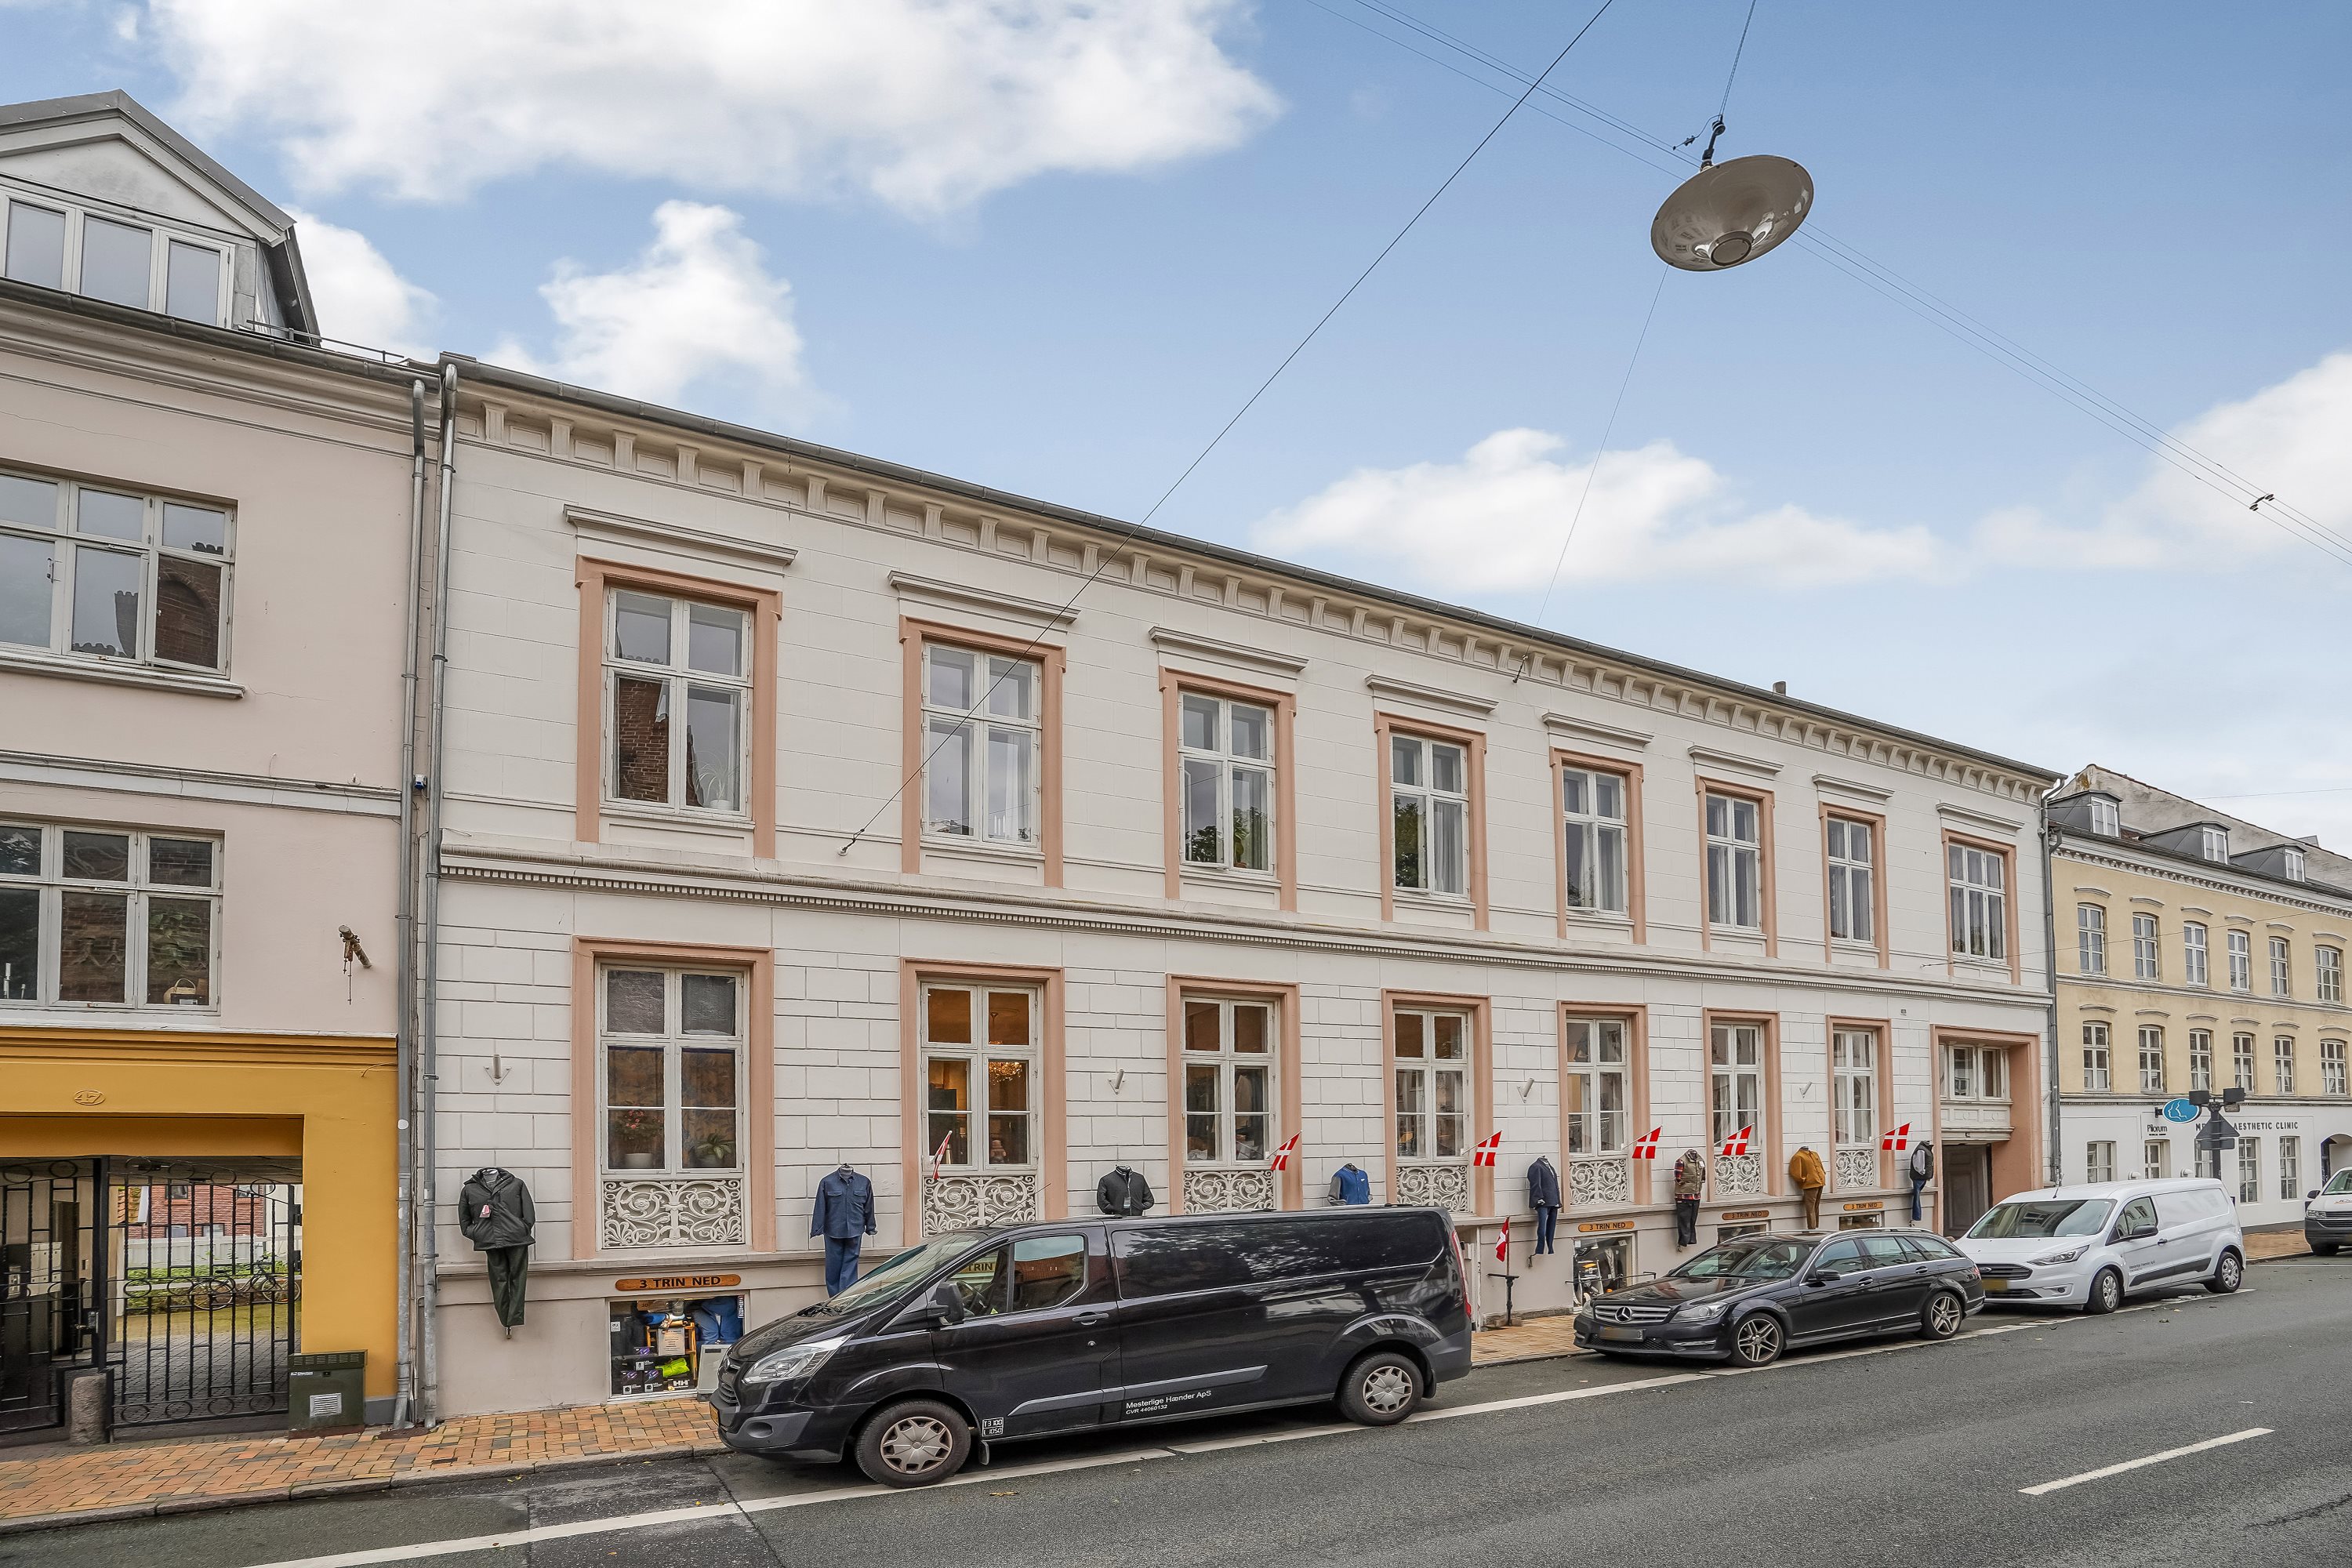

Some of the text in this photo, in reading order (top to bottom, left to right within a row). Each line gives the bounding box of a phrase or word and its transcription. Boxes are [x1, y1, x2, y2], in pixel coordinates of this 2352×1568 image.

[2234, 1122, 2272, 1131] AESTHETIC
[639, 1276, 721, 1288] 3 TRIN NED
[1126, 1390, 1212, 1409] Mesterlige Hænder ApS
[1140, 1404, 1168, 1413] 44060132
